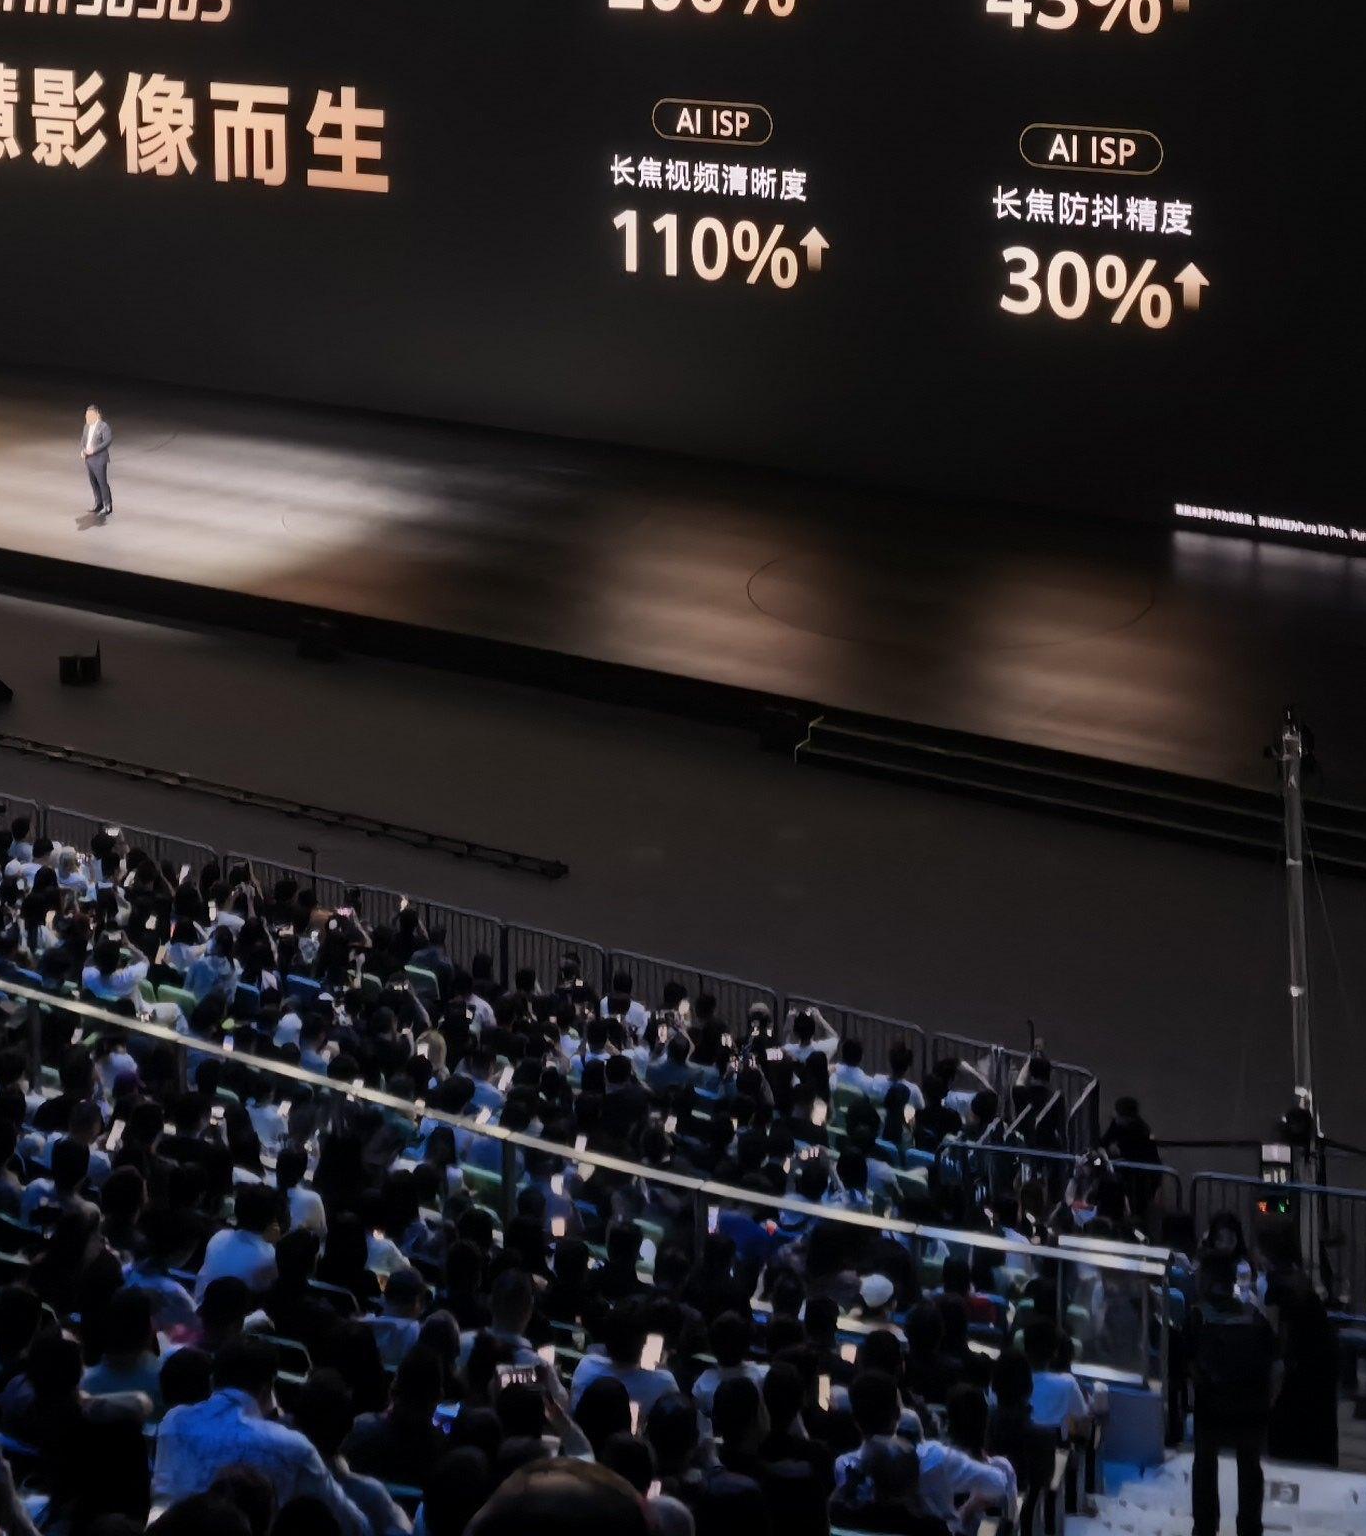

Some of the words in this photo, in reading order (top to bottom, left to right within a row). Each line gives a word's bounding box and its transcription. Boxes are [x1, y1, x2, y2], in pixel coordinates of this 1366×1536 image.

[676, 108, 703, 135] AI
[712, 109, 750, 137] ISP
[1048, 135, 1078, 164] AI
[1091, 136, 1136, 166] ISP
[610, 154, 807, 202] 长焦视频清晰度
[992, 185, 1192, 236] 长焦防抖精度
[613, 209, 798, 289] 110%
[999, 246, 1172, 329] 30%
